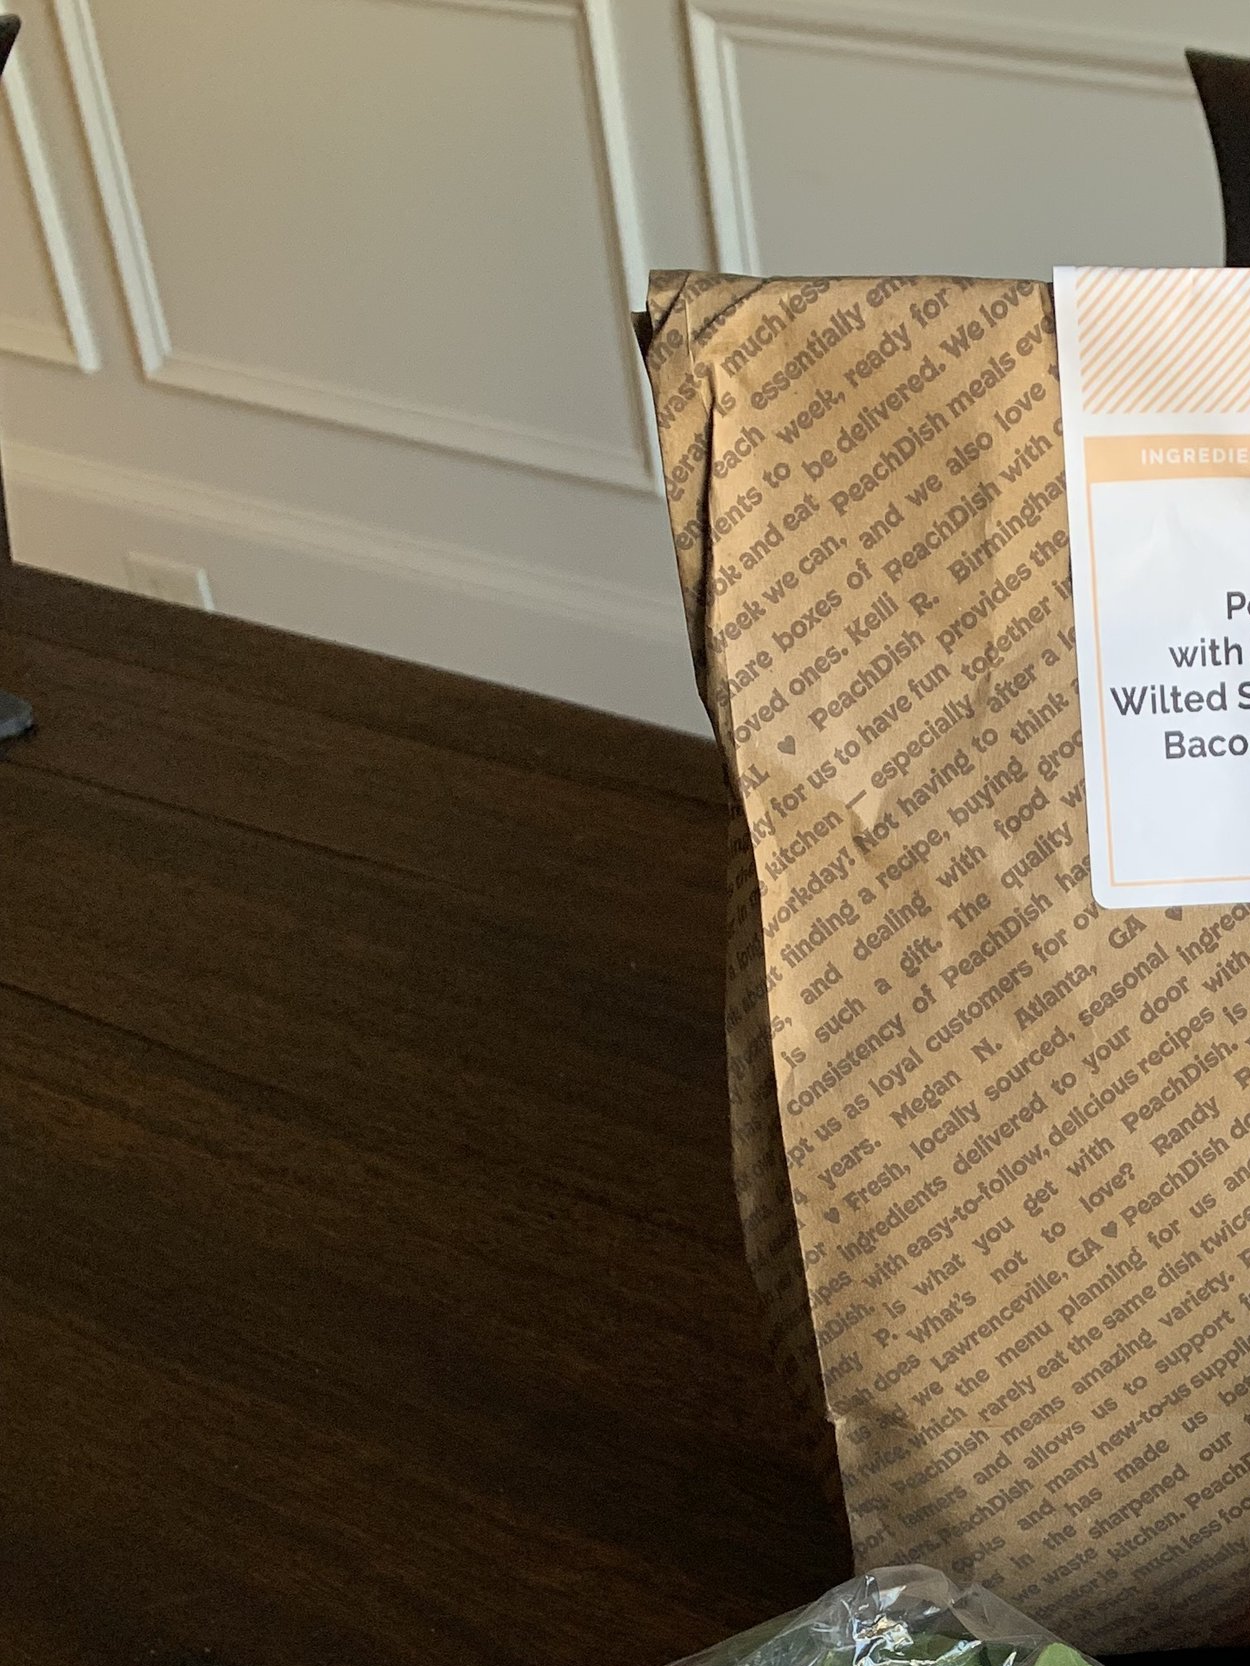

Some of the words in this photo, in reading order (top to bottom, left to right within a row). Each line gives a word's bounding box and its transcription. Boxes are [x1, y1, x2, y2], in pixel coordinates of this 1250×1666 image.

[775, 389, 846, 445] week,
[843, 322, 913, 389] ready
[909, 286, 949, 328] for
[801, 449, 838, 483] be
[836, 354, 947, 454] delivered.
[938, 320, 986, 359] We
[978, 278, 1044, 329] love
[858, 501, 906, 550] and
[905, 474, 944, 507] we
[945, 432, 994, 476] also
[993, 382, 1047, 433] love
[882, 480, 1002, 585] PeachDish
[1000, 435, 1054, 483] with
[788, 645, 850, 697] ones.
[844, 590, 900, 647] Kelli
[935, 563, 1033, 656] provides
[1028, 529, 1065, 568] the
[1169, 636, 1243, 668] with
[1110, 682, 1227, 715] Wilted
[762, 846, 859, 941] workday!
[850, 811, 901, 857] Not
[895, 747, 976, 818] having
[970, 728, 999, 754] to
[782, 898, 861, 969] finding
[857, 886, 878, 906] a
[875, 828, 951, 890] recipe,
[946, 754, 1029, 828] buying
[799, 961, 844, 1006] and
[852, 889, 933, 962] dealing
[935, 844, 988, 889] with
[992, 785, 1051, 840] food
[787, 1012, 907, 1116] consistency
[911, 982, 937, 1015] of
[939, 893, 1054, 990] PeachDish
[814, 998, 866, 1044] such
[873, 977, 893, 996] a
[899, 937, 944, 979] gift.
[946, 892, 992, 931] The
[1000, 821, 1075, 889] quality
[816, 1137, 882, 1192] years.
[889, 1069, 963, 1129] Megan
[970, 1037, 1004, 1064] N.
[1013, 964, 1099, 1032] Atlanta,
[1107, 913, 1148, 950] GA
[835, 1175, 948, 1263] ingredients
[952, 1090, 1049, 1176] delivered
[1050, 1071, 1078, 1096] to
[1081, 1024, 1132, 1076] your
[1139, 975, 1190, 1026] door
[1149, 1095, 1221, 1157] Randy
[954, 1368, 991, 1398] the
[994, 1319, 1054, 1369] menu
[1057, 1245, 1148, 1326] planning
[1062, 1486, 1104, 1518] has
[1113, 1438, 1171, 1485] made
[1180, 1410, 1209, 1434] us
